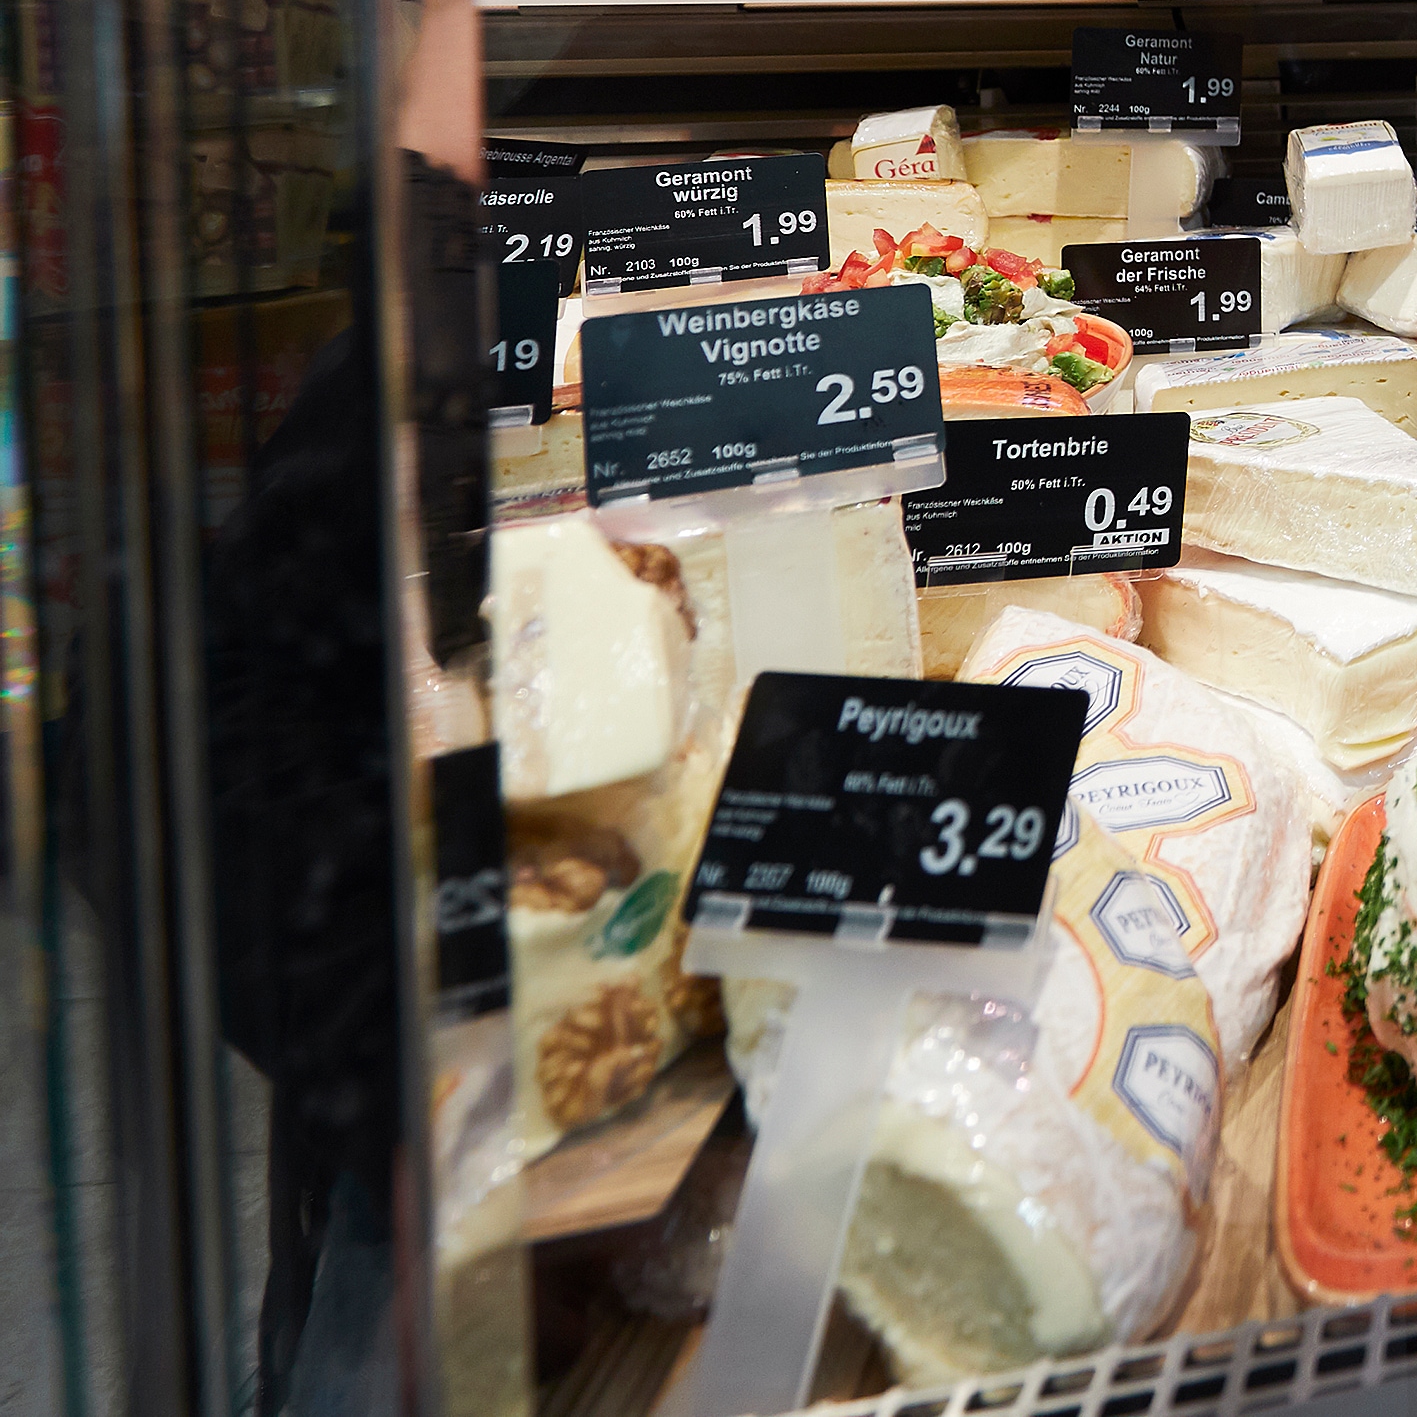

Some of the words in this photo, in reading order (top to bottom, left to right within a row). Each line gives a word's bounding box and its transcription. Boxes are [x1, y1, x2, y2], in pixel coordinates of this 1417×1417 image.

[1125, 35, 1192, 49] Geramont
[1140, 52, 1178, 65] Natur
[1182, 76, 1234, 103] 1.99
[1074, 105, 1088, 113] Nr.
[1099, 104, 1119, 112] 2244
[1129, 105, 1150, 114] 100g
[534, 152, 577, 166] Argental
[875, 158, 934, 178] Géra
[656, 166, 752, 187] Geramont
[674, 184, 739, 202] würzig
[675, 209, 695, 219] 60%
[698, 208, 717, 216] Fett
[743, 210, 817, 247] 1.99
[502, 234, 574, 264] 2.19
[1121, 247, 1200, 263] Geramont
[590, 265, 611, 276] Nr.
[625, 259, 656, 271] 2103
[669, 257, 699, 267] 100g
[1116, 269, 1142, 283] der
[1147, 266, 1206, 281] Frische
[1135, 285, 1152, 293] 64%
[1190, 291, 1252, 322] 1.99
[658, 296, 860, 338] Weinbergkäse
[1129, 329, 1153, 338] 100g
[489, 339, 540, 372] 19
[700, 331, 821, 366] Vignotte
[718, 371, 749, 386] 75%
[753, 368, 781, 381] Fett
[815, 366, 925, 426] 2.59
[647, 448, 692, 470] 2652
[712, 442, 756, 460] 100g
[992, 435, 1109, 460] Tortenbrie
[1011, 479, 1035, 491] 50%
[1038, 478, 1061, 489] Fett
[1084, 486, 1173, 532] 0.49
[1099, 532, 1163, 545] AKTION
[945, 543, 981, 557] 2612
[997, 541, 1031, 556] 100g
[837, 696, 983, 744] Peyrigoux
[919, 797, 1047, 878] 3.29
